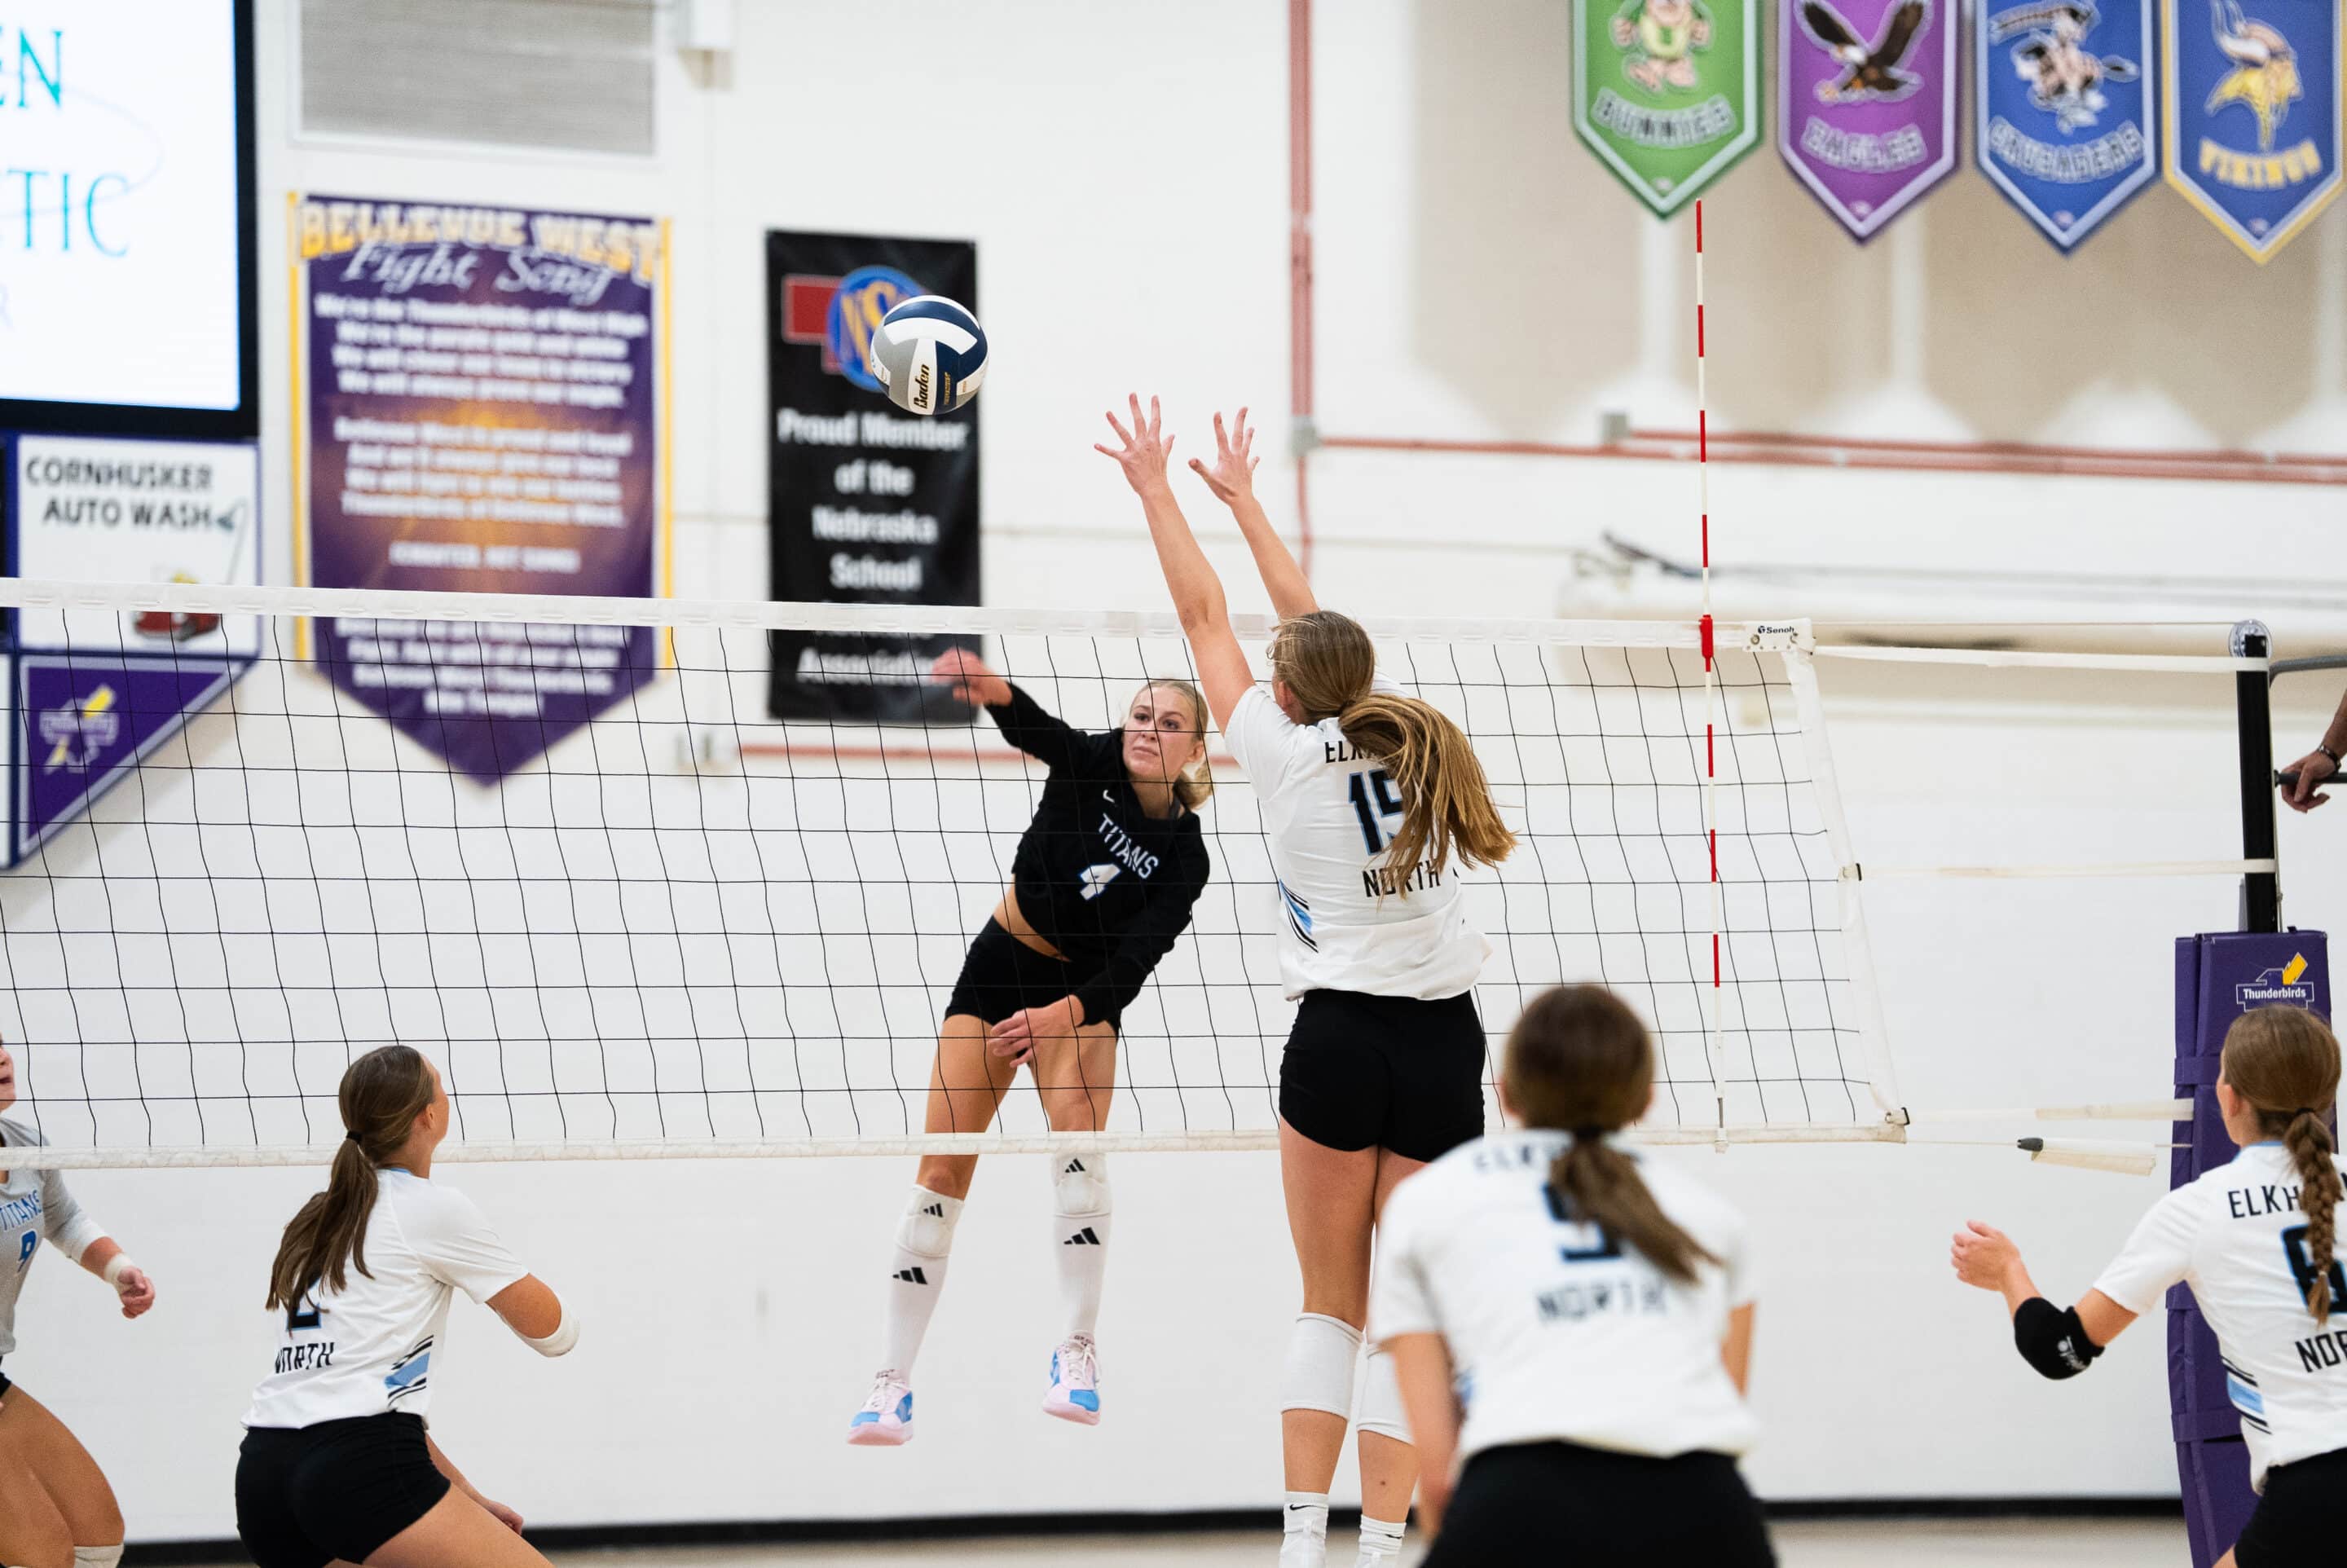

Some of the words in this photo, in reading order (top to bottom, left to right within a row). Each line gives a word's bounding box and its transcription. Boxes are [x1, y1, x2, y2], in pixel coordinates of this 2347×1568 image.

[301, 201, 527, 259] BELLEVUE
[530, 214, 658, 287] WEST
[340, 240, 481, 294] Fight
[494, 244, 619, 306] Song
[913, 363, 930, 409] Baden
[777, 407, 858, 446] Proud
[861, 411, 970, 451] Member
[26, 456, 213, 490] CORNHUSKER
[833, 458, 867, 494] of
[867, 460, 915, 496] the
[42, 496, 122, 528] AUTO
[130, 501, 212, 530] WASH
[812, 505, 939, 544] Nebraska
[830, 553, 923, 592] School
[1766, 626, 1794, 634] Senoh
[1098, 813, 1159, 879] TITANS
[1080, 864, 1121, 901] 4
[2243, 988, 2306, 1000] Thunderbirds
